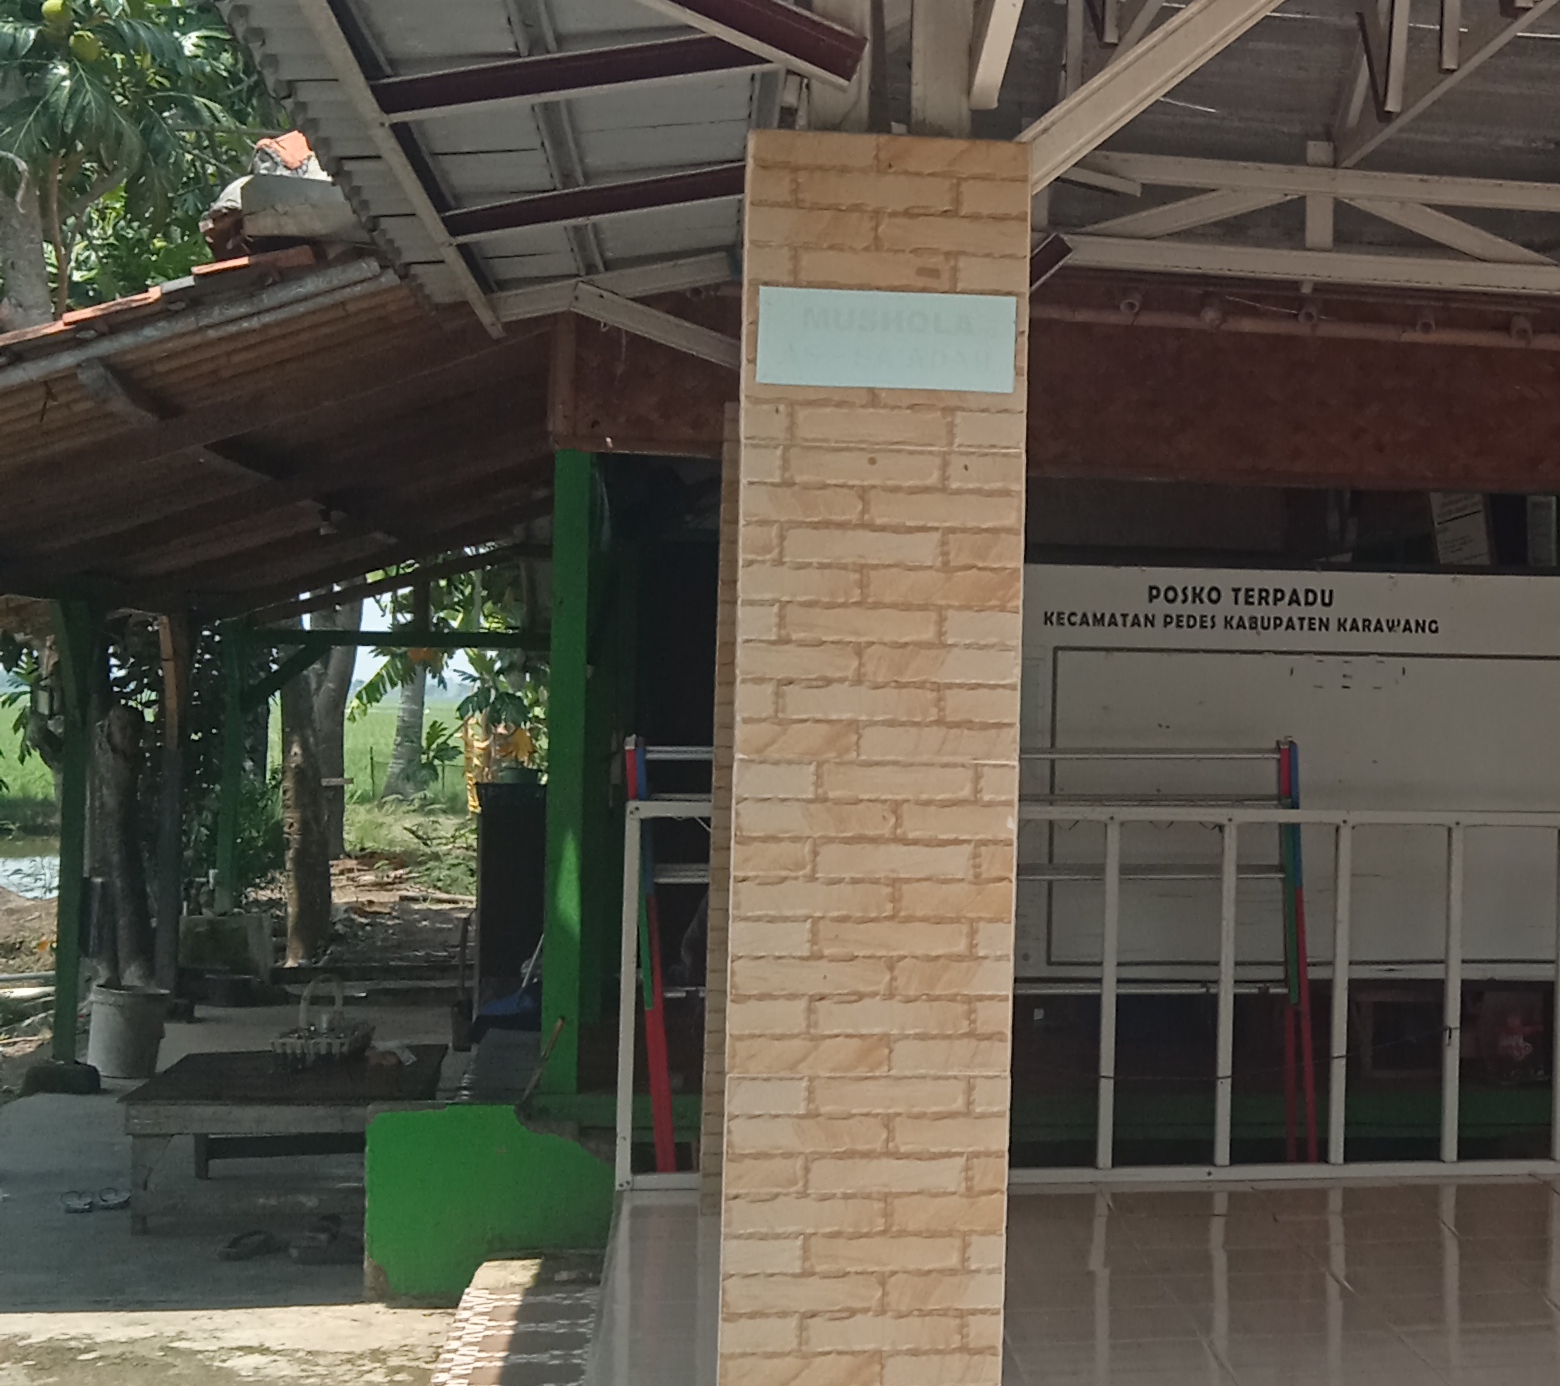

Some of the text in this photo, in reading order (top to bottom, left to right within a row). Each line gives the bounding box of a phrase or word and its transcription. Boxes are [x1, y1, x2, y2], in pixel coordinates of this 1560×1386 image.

[803, 307, 975, 336] MUSHOLA
[1147, 584, 1334, 608] POSKO TERPADU
[1042, 610, 1440, 635] KECAMATAN PEDES KABUPATEN KARAWANG
